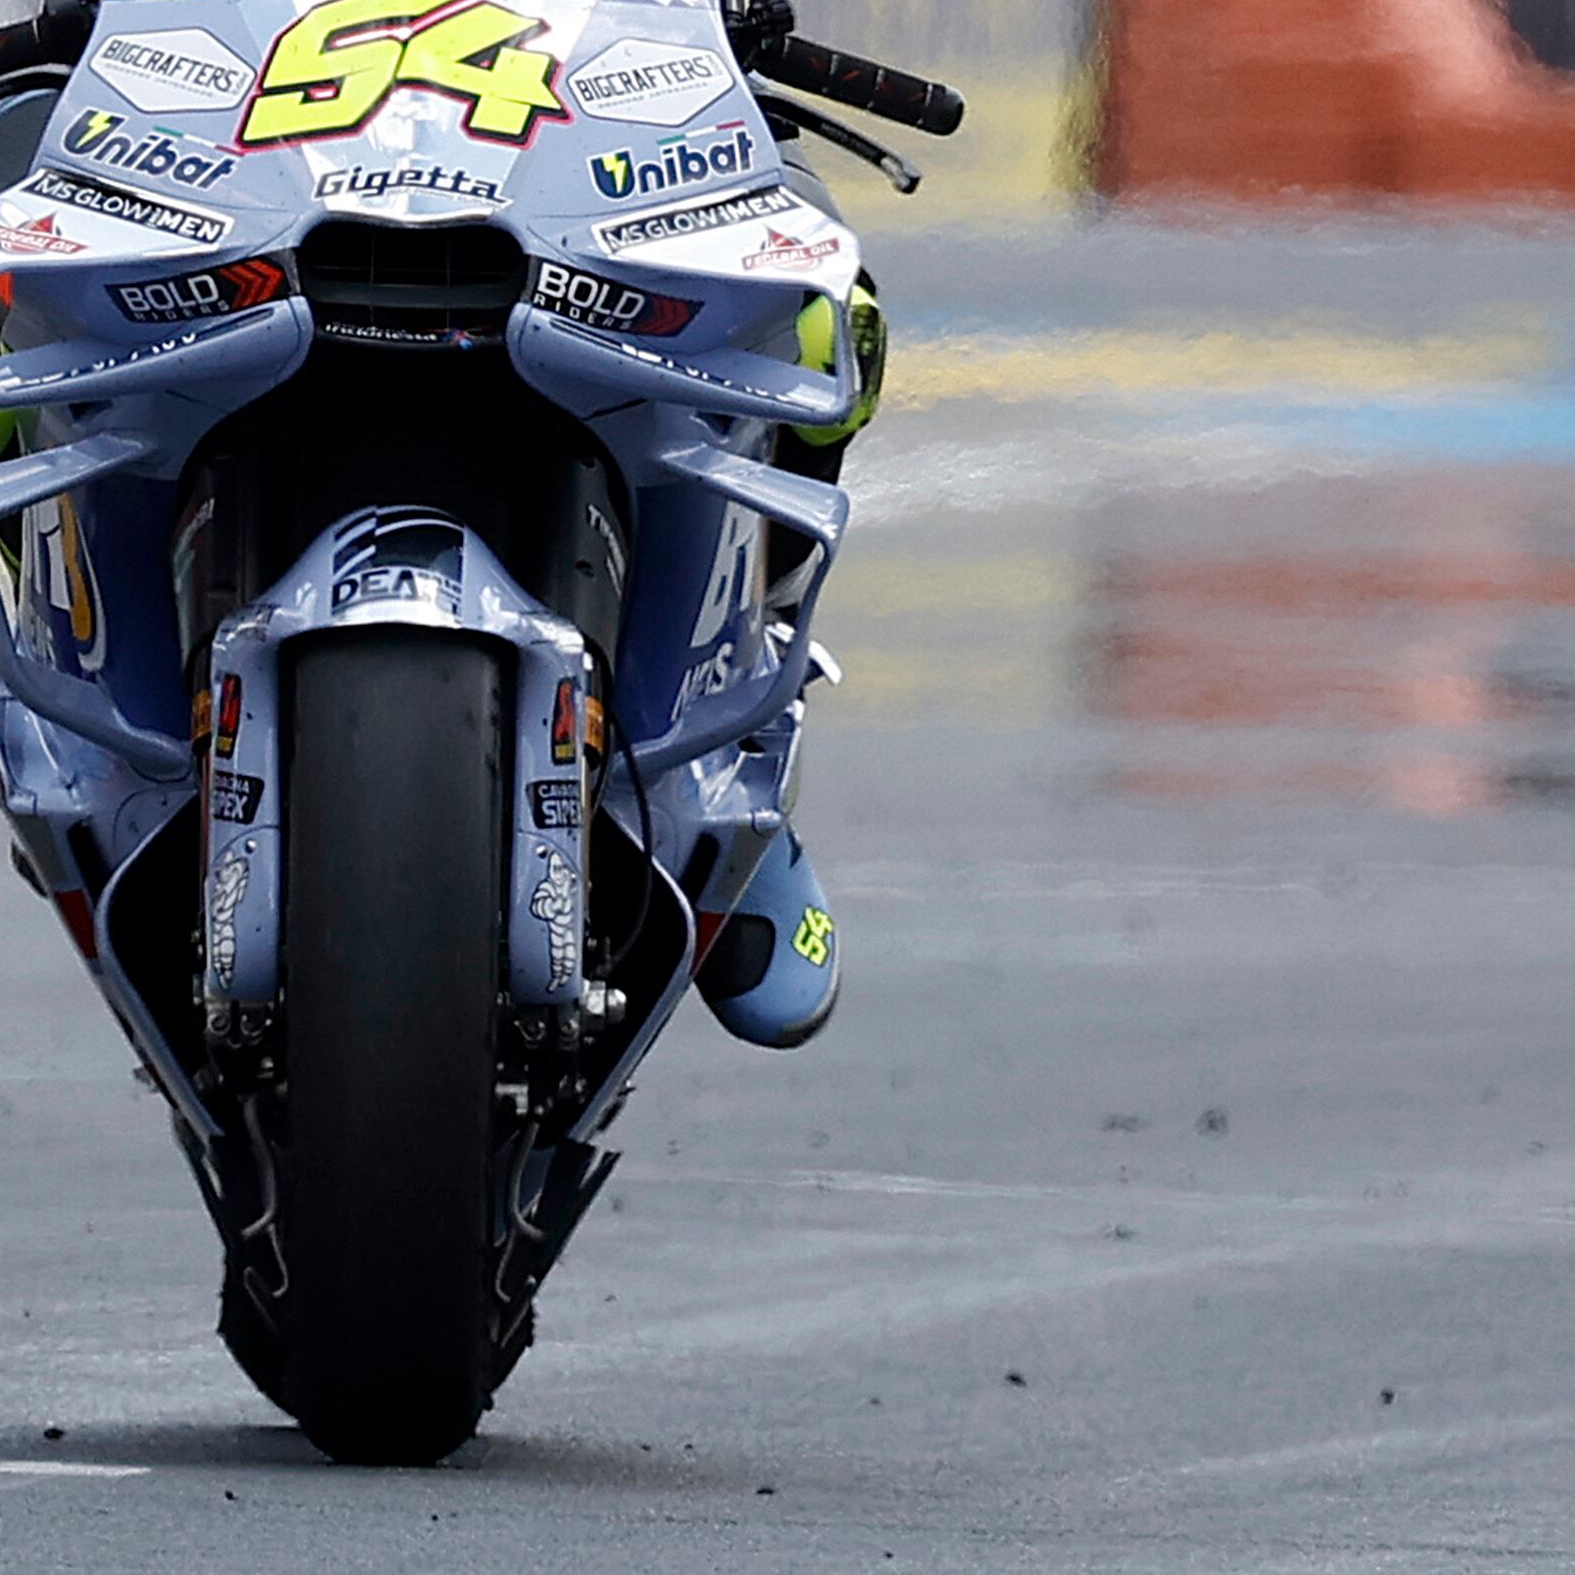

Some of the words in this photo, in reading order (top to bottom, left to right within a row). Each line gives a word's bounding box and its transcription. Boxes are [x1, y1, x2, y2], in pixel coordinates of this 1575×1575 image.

[102, 38, 239, 93] BIGCRAFTERS
[575, 56, 712, 103] BIGCRAFTERS
[63, 108, 237, 189] Unibat
[590, 130, 754, 199] Unibat
[314, 166, 507, 204] Gigetta
[745, 249, 807, 270] FEDERAL
[809, 242, 837, 257] OIL
[119, 273, 219, 313] BOLD
[537, 263, 647, 320] BOLD
[792, 905, 833, 966] 54
